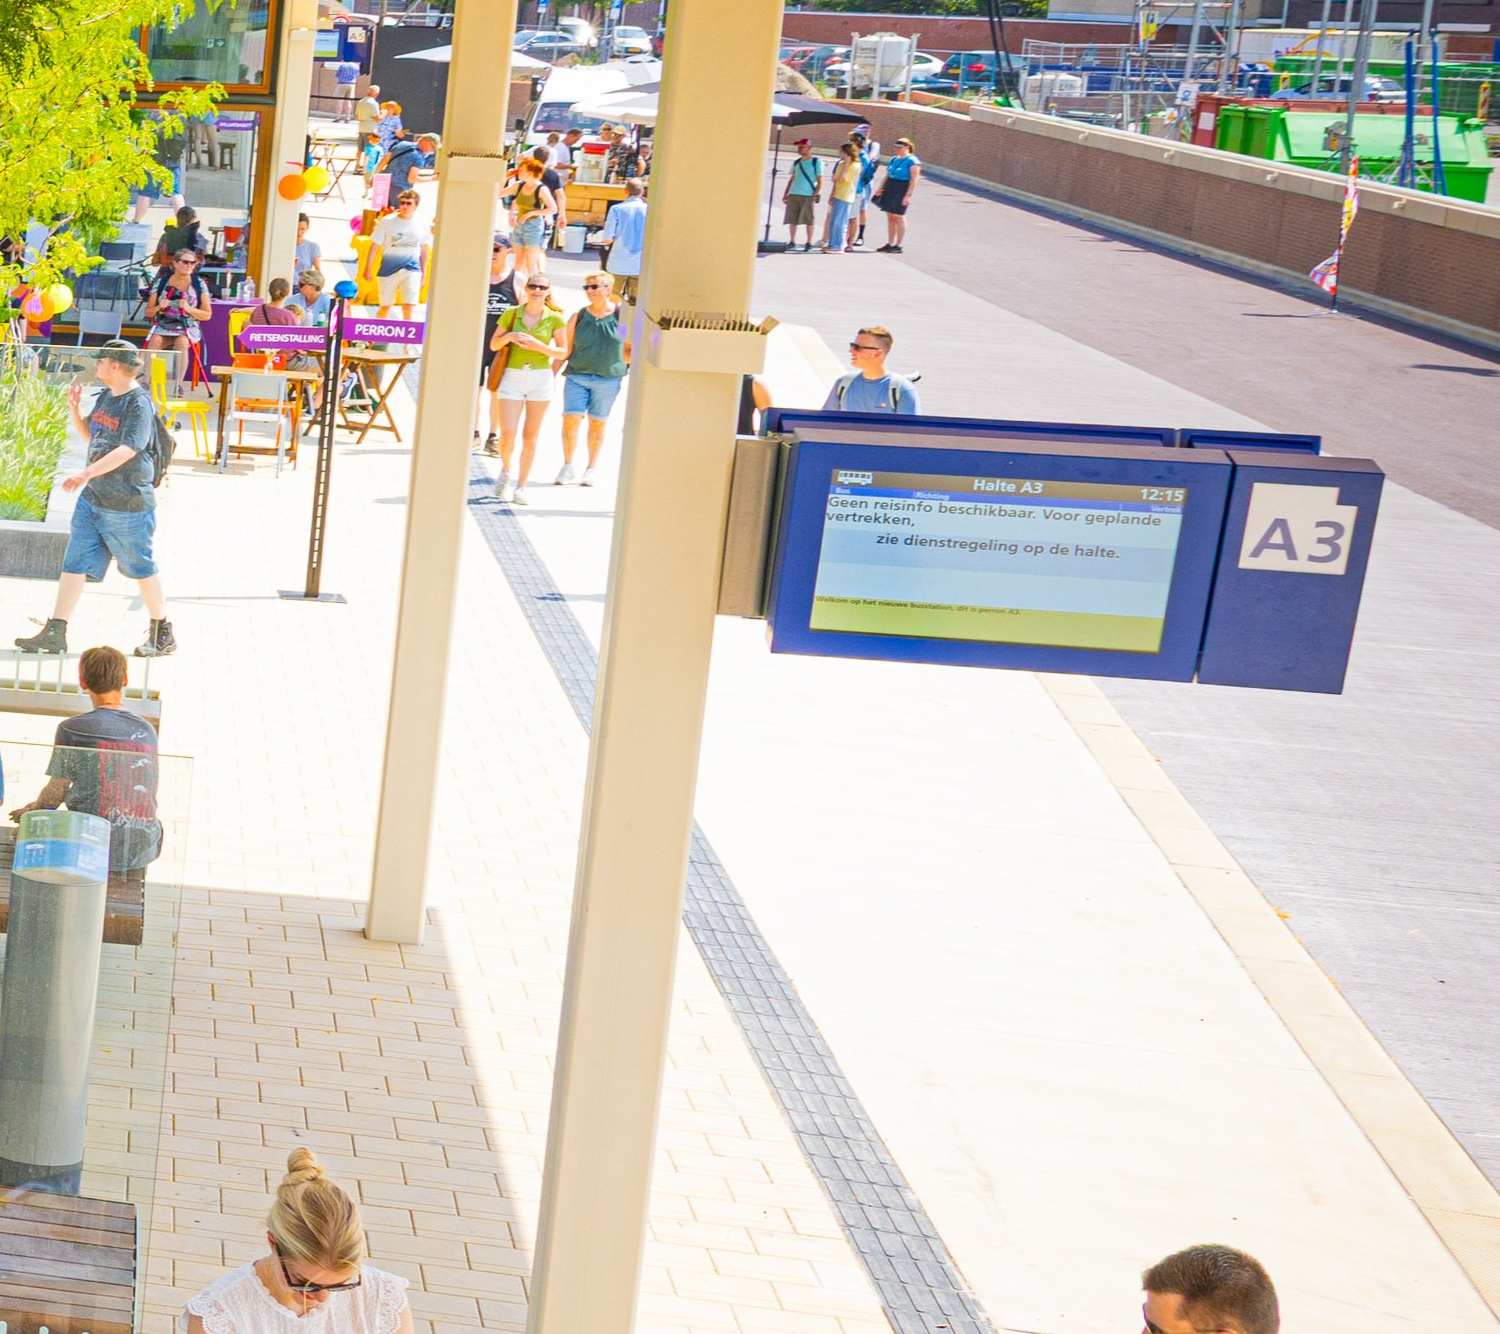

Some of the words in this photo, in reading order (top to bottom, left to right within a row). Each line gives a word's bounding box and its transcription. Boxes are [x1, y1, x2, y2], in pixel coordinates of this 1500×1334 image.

[349, 33, 365, 41] A5
[249, 332, 325, 344] FIETSENSTALLING
[354, 323, 406, 338] PERRON
[407, 326, 417, 339] 2
[973, 479, 1017, 493] Halte
[1019, 481, 1044, 494] A3
[1140, 488, 1185, 502] 12:15
[828, 496, 869, 509] Geen
[874, 499, 933, 513] reisinfo
[938, 502, 1036, 519] beschikbaar.
[1043, 508, 1081, 522] Voor
[1085, 512, 1162, 526] geplande
[826, 512, 916, 527] vertrekken,
[876, 533, 900, 545] zie
[903, 534, 1018, 554] dienstregeling
[1023, 544, 1044, 556] op
[1049, 543, 1070, 556] de
[1074, 544, 1120, 559] halte.
[1248, 518, 1345, 564] A3
[878, 600, 908, 608] nieuwe
